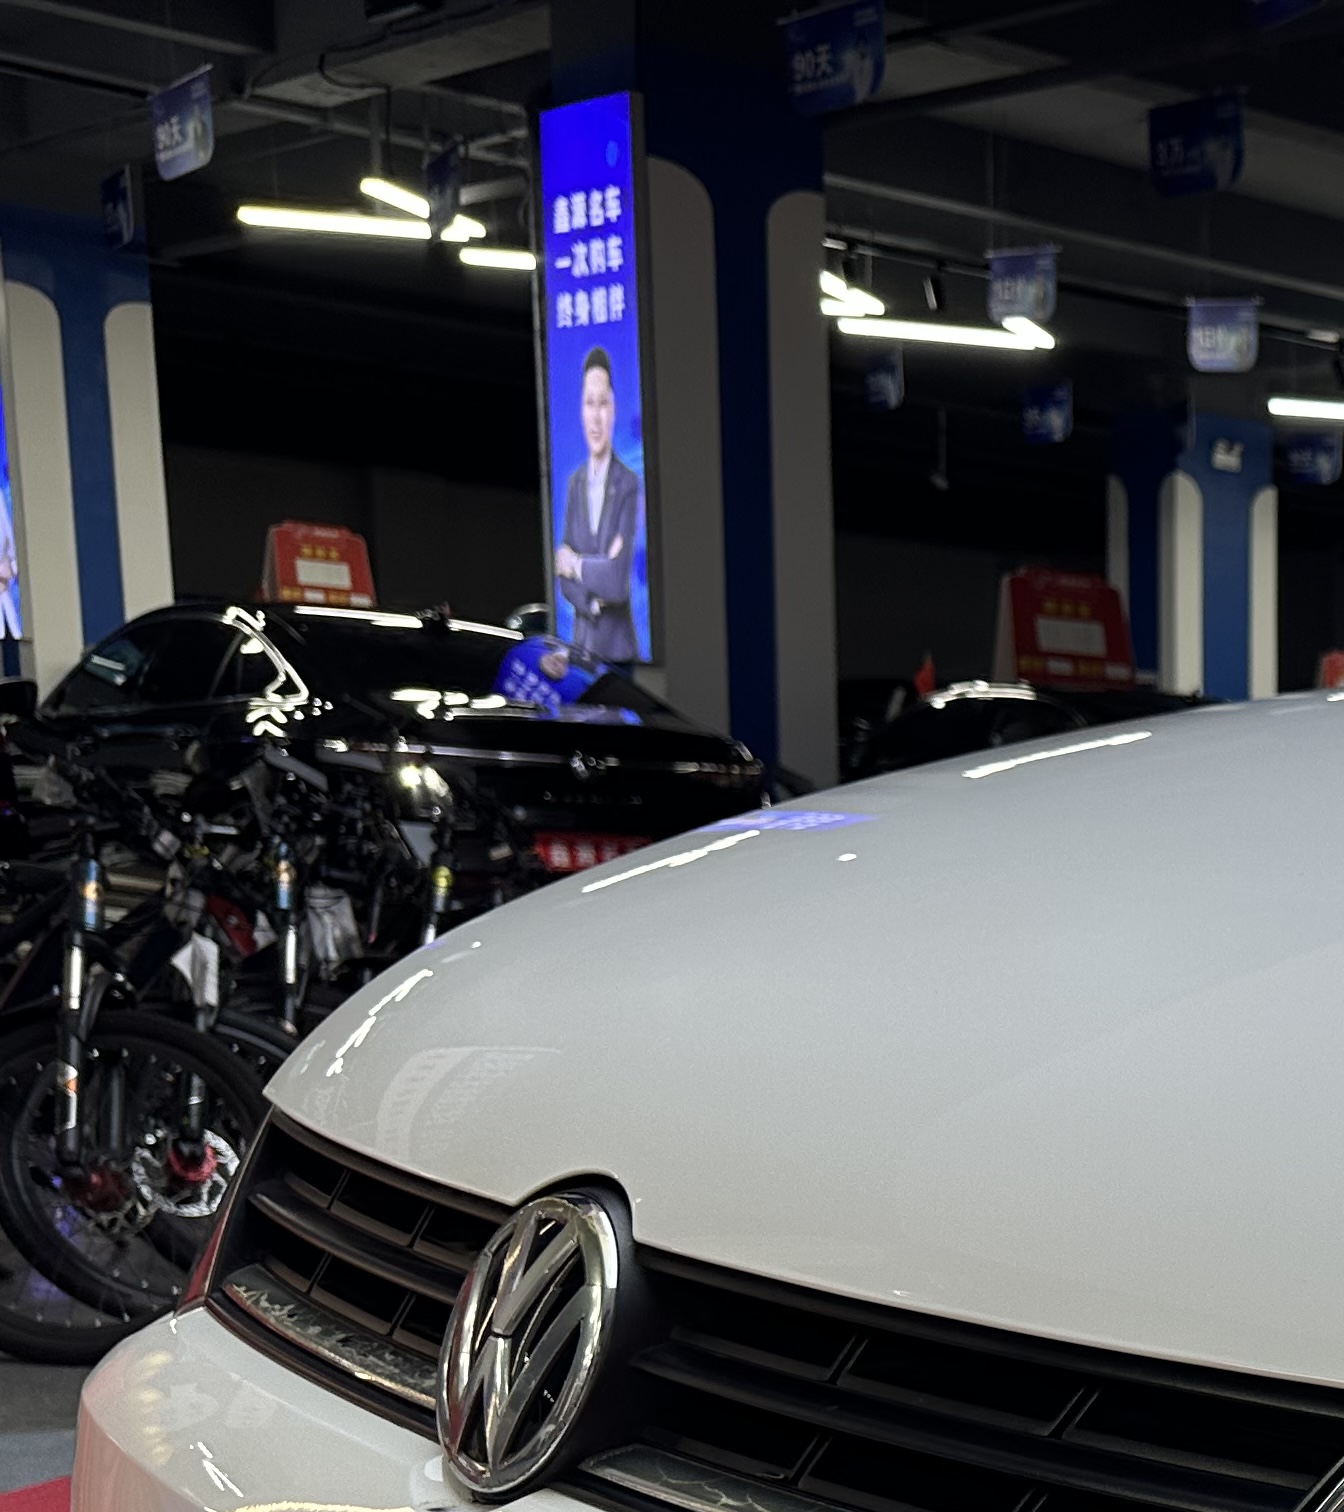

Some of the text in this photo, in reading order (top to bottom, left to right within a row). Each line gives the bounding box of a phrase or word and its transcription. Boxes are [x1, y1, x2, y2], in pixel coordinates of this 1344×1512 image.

[552, 184, 622, 235] 鑫源名车
[554, 233, 624, 279] 一次购车
[556, 282, 626, 329] 终身相伴
